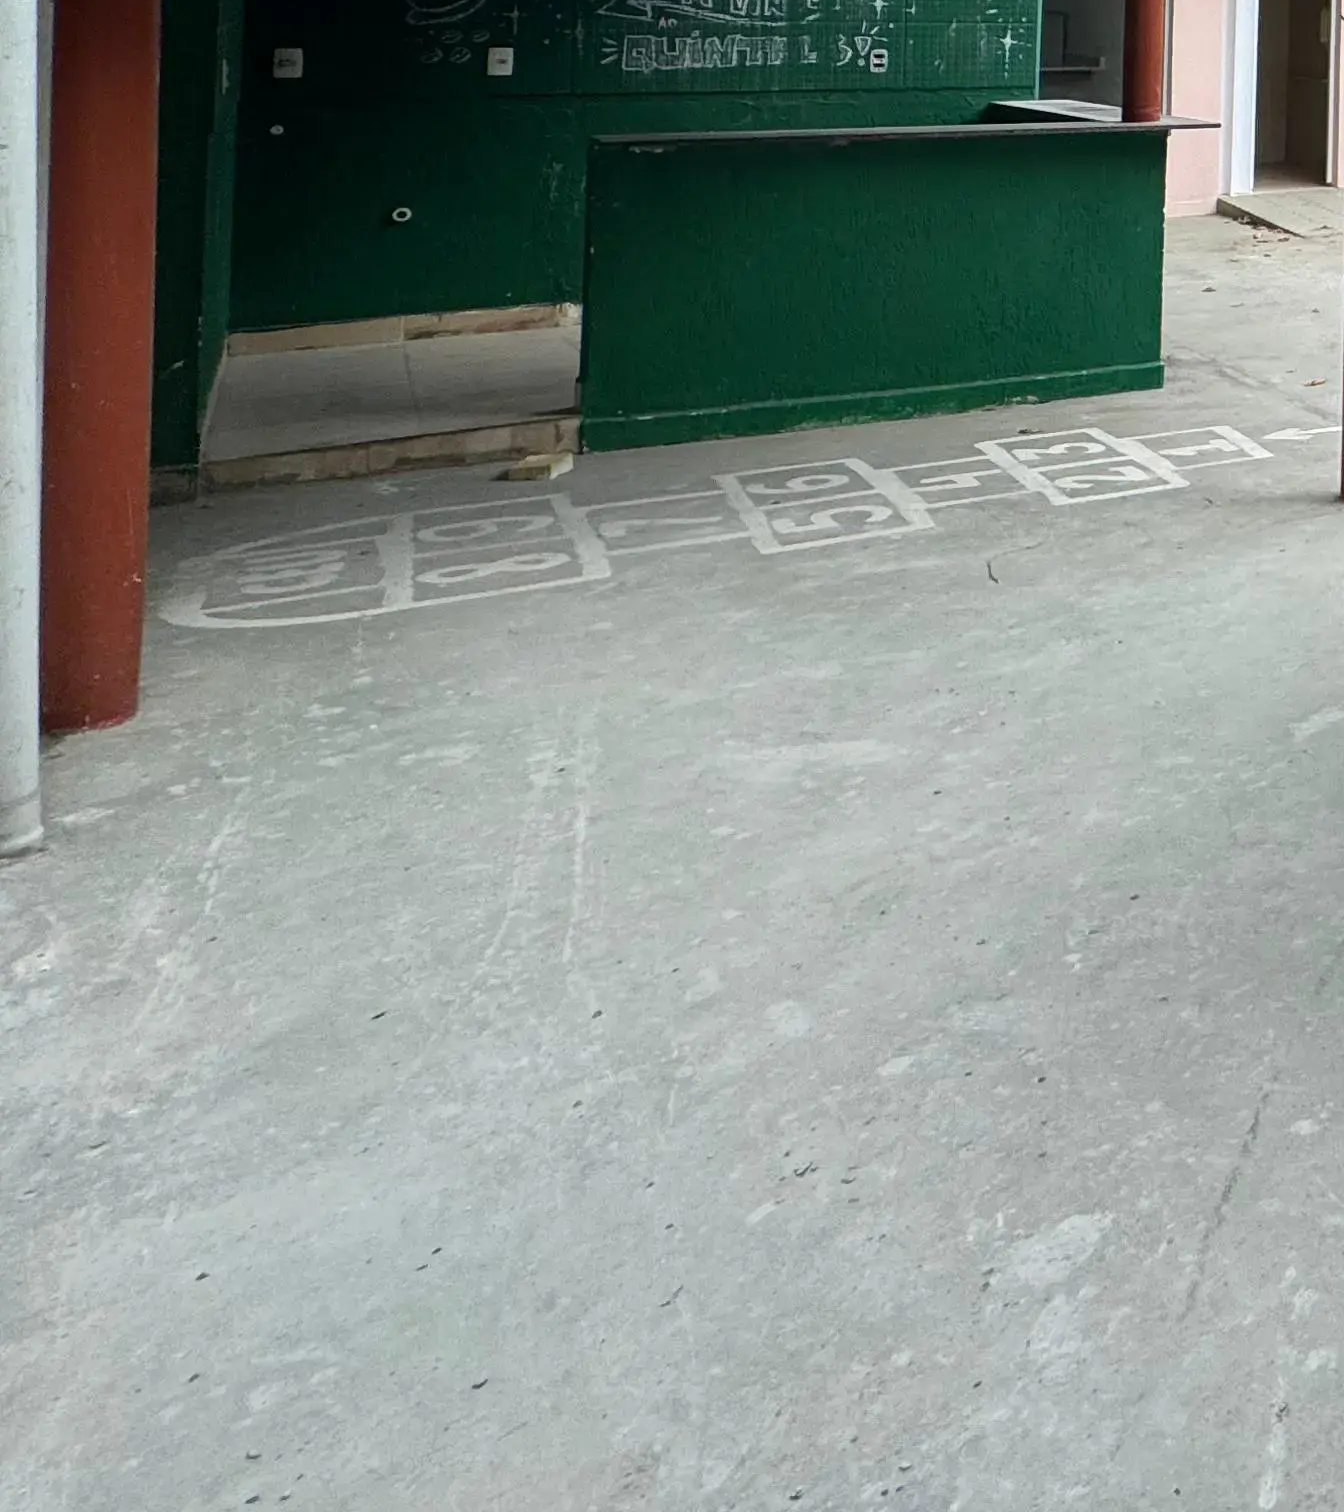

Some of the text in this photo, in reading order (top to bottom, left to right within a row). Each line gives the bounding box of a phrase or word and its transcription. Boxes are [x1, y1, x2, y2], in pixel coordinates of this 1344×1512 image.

[1011, 441, 1106, 461] 3
[746, 474, 850, 494] 6
[1055, 466, 1151, 489] 2
[415, 516, 555, 542] 9
[772, 504, 893, 534] 5
[414, 552, 572, 584] 8
